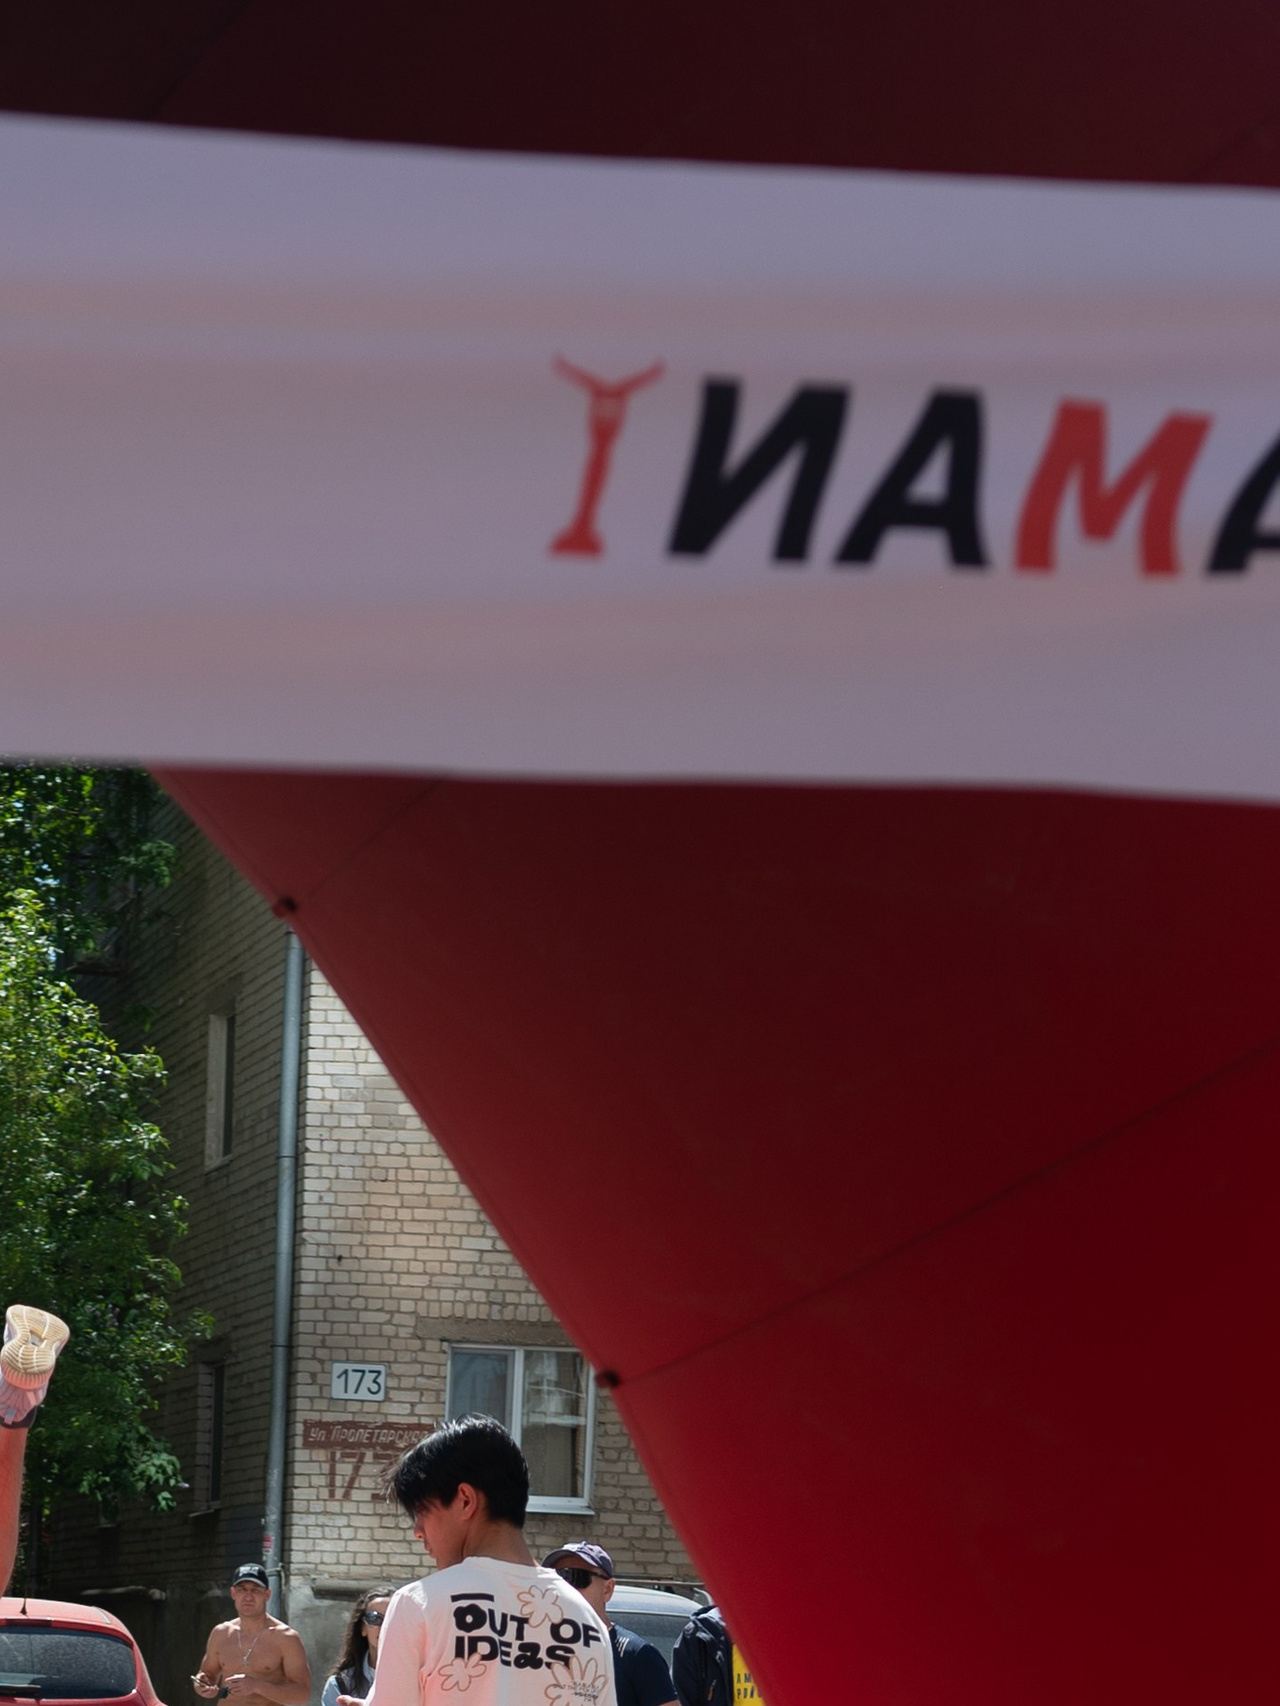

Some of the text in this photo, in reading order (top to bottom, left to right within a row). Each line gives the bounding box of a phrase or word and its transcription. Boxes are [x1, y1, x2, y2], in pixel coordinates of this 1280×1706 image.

[336, 1368, 383, 1395] 173
[453, 1603, 602, 1648] OUT OF
